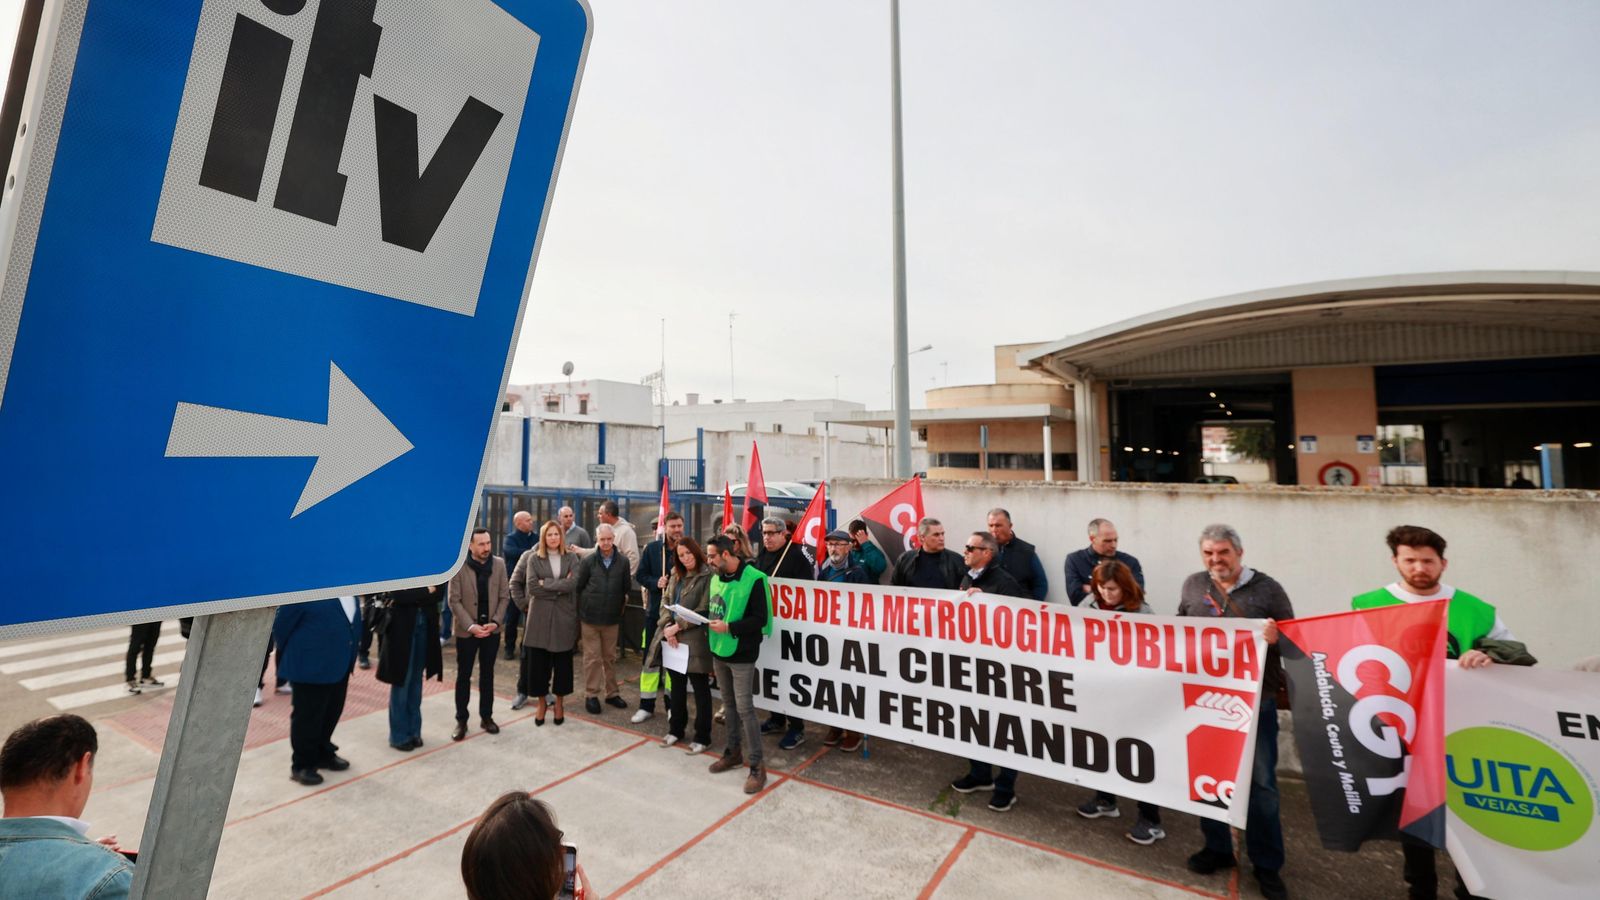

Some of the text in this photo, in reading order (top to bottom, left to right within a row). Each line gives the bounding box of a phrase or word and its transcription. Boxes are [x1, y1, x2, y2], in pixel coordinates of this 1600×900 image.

[199, 0, 504, 253] itv
[813, 588, 841, 626] DE
[848, 591, 875, 631] LA
[882, 594, 1076, 659] METROLOGÍA
[1083, 614, 1260, 682] PÚBLICA
[781, 629, 1078, 713] NO AL CIERRE
[790, 673, 866, 720] SAN
[879, 689, 1155, 784] FERNANDO
[1326, 723, 1345, 758] Ceuta
[1332, 760, 1347, 770] y
[1445, 754, 1575, 805] UITA
[1339, 771, 1363, 814] Melilla
[1474, 796, 1545, 818] VEIASA
